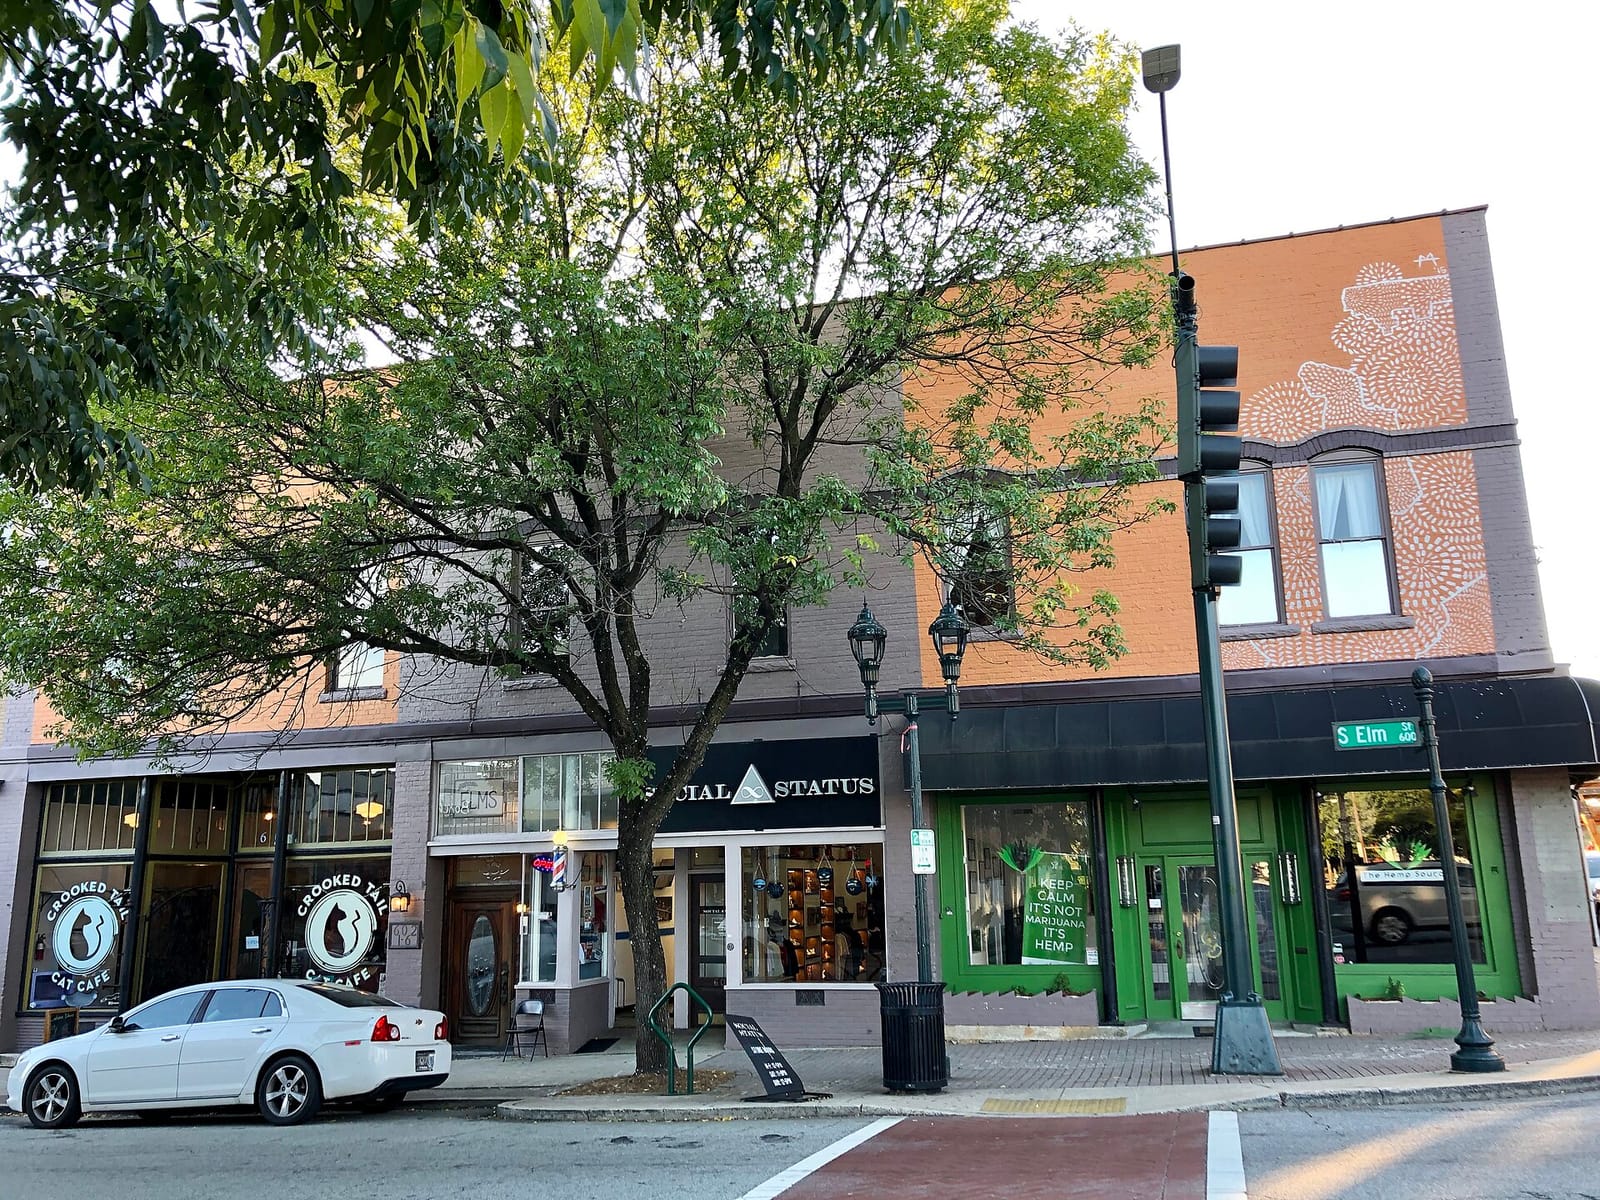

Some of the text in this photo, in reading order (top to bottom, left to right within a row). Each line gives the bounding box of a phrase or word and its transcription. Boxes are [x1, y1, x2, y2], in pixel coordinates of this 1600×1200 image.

[1337, 721, 1413, 744] S Elm St
[1398, 732, 1417, 742] 600
[645, 778, 874, 802] SCIAL STATUS
[460, 790, 498, 809] ELMS
[912, 831, 919, 844] 2
[1040, 878, 1074, 890] KEEP
[47, 881, 129, 922] CROOKED TAIL
[297, 874, 389, 917] CROOKED TAIL
[1037, 890, 1075, 903] CALM
[1029, 902, 1083, 917] IT'S NOT
[1025, 914, 1086, 929] MARIJUANA
[393, 925, 417, 937] 602
[1043, 927, 1066, 939] IT'S
[1035, 938, 1074, 953] HEMP
[51, 969, 111, 992] CAT CAFE
[305, 968, 331, 983] CT
